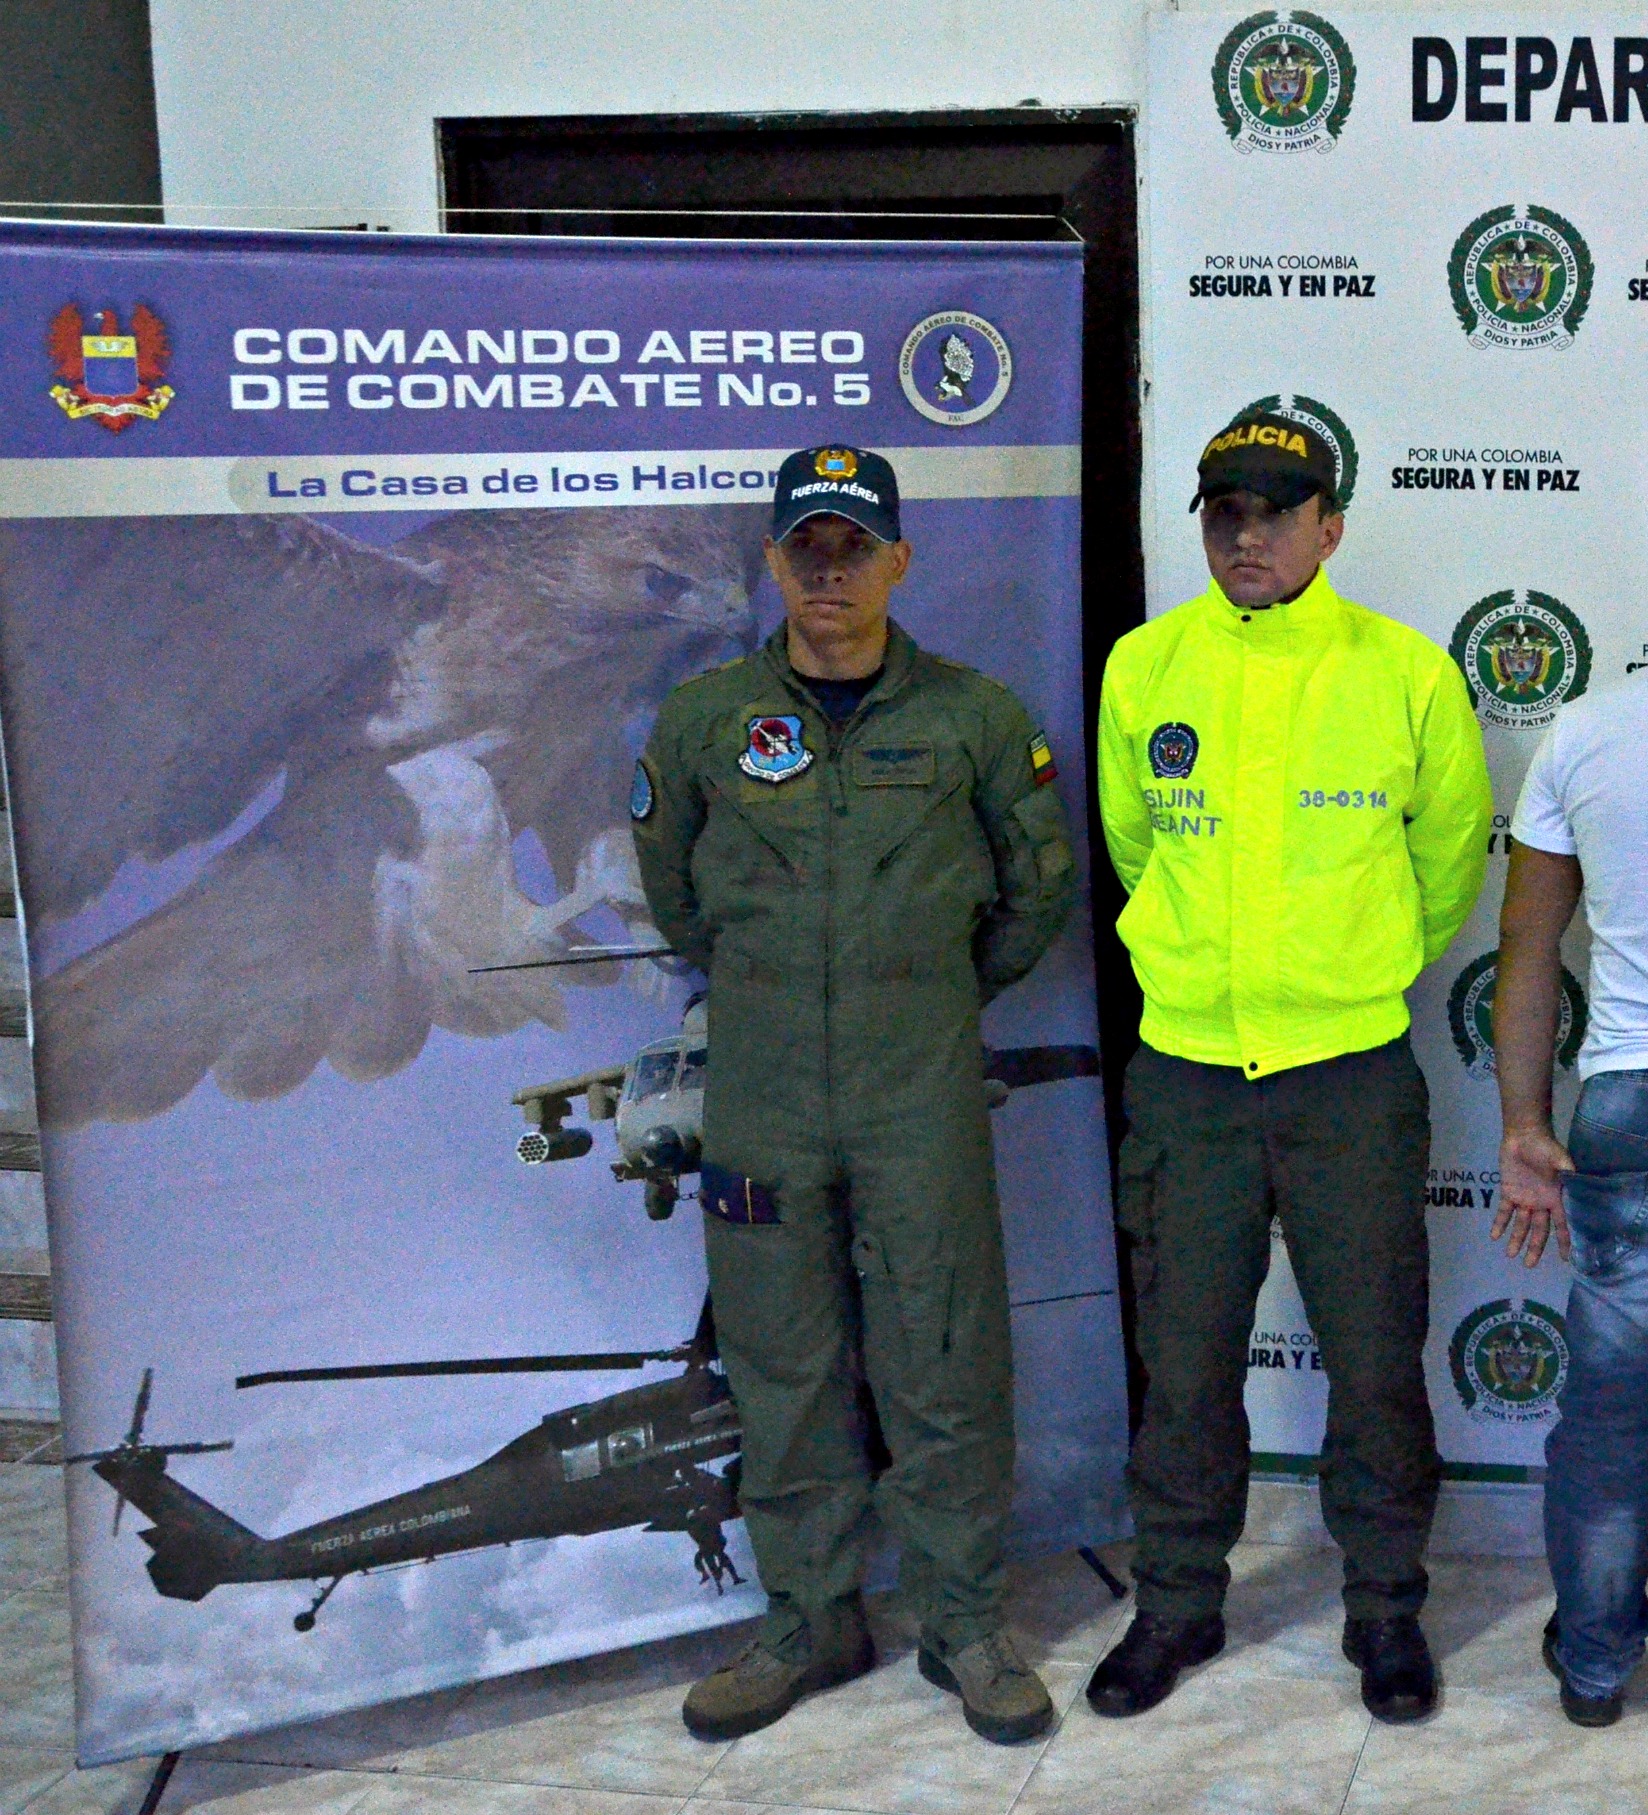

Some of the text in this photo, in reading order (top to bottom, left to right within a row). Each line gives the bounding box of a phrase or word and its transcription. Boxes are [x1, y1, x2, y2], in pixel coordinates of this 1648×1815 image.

[1305, 32, 1337, 88] COLOMBIA
[1285, 102, 1333, 136] NACIONAL
[1285, 135, 1321, 150] PATRIA
[1206, 256, 1358, 269] POR UNA COLOMBIA
[1542, 228, 1576, 285] COLOMBIA
[1190, 275, 1375, 297] SEGURA Y EN PAZ
[1522, 299, 1570, 332] NACIONAL
[233, 328, 865, 364] COMANDO AEREO
[1521, 331, 1558, 346] PATRIA
[903, 331, 922, 374] COMANDO
[230, 374, 871, 409] DE COMBATE No. 5
[1409, 448, 1562, 463] POR UNA COLOMBIA
[267, 471, 327, 497] La
[341, 470, 468, 496] Casa
[482, 468, 538, 493] de
[551, 467, 619, 492] los
[1392, 467, 1580, 491] SEGURA Y EN PAZ
[791, 481, 838, 500] FUERZA
[1542, 613, 1574, 668] COLOMBIA
[1522, 682, 1569, 713] NACIONAL
[1521, 713, 1556, 726] PATRIA
[1144, 788, 1204, 809] SIJIN
[1299, 790, 1387, 808] 38-0314
[1443, 1169, 1476, 1183] UNA
[1480, 1188, 1493, 1208] Y
[1255, 1332, 1287, 1345] UNA
[1291, 1350, 1304, 1369] Y
